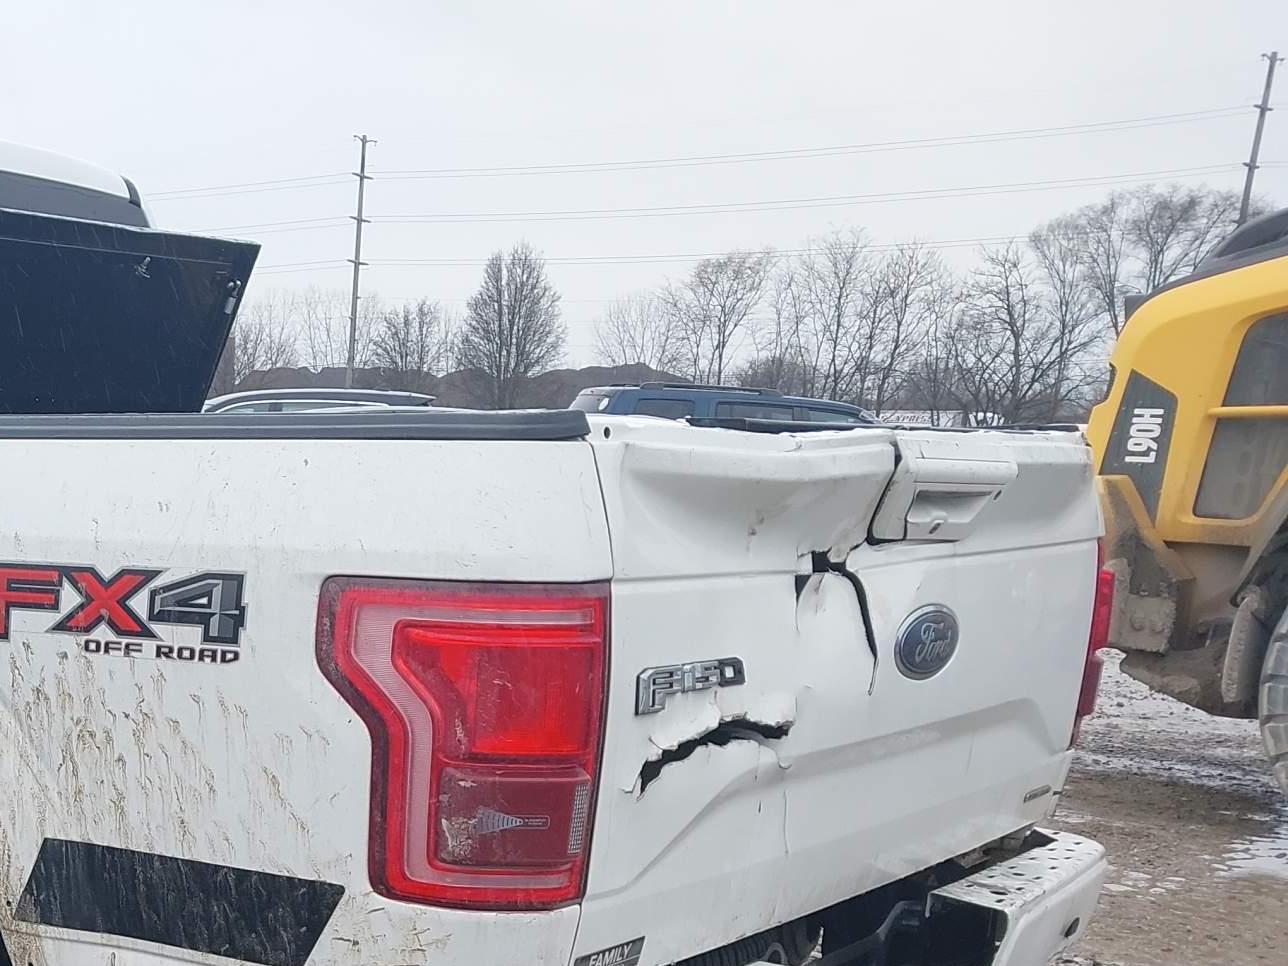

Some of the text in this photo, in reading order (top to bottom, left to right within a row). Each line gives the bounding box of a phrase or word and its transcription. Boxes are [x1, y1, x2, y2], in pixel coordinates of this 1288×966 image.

[1124, 407, 1164, 463] L90H
[84, 638, 240, 665] OFF ROAD
[915, 622, 951, 664] Ford
